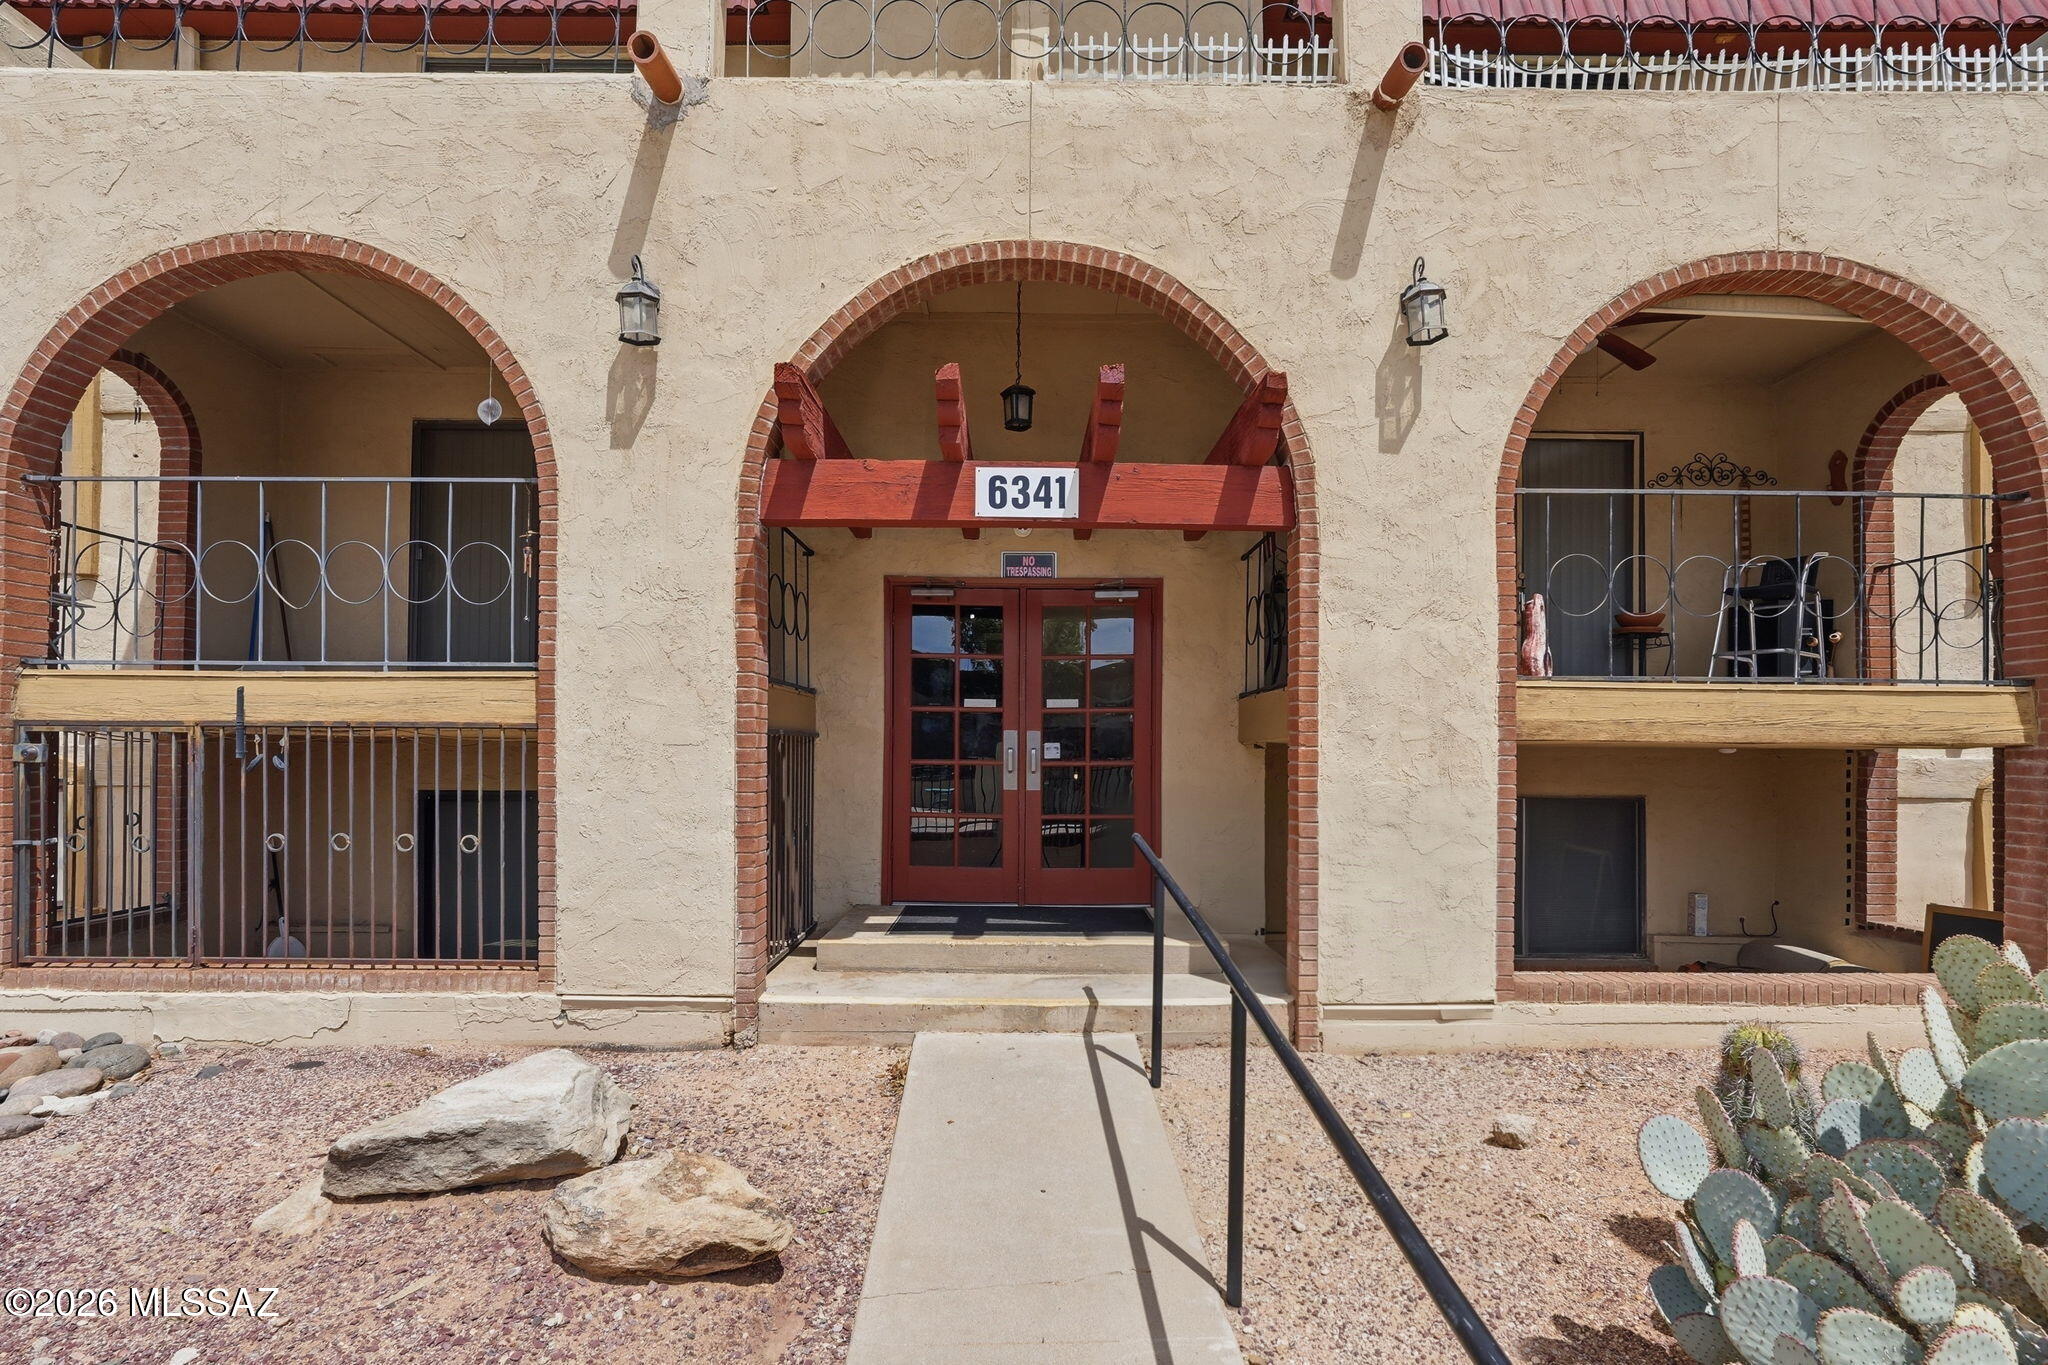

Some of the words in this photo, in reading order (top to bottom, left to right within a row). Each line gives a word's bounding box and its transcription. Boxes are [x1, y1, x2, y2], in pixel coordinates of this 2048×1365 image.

[988, 475, 1066, 509] 6341
[1022, 556, 1035, 566] NO
[1006, 567, 1052, 577] TRESPASSING
